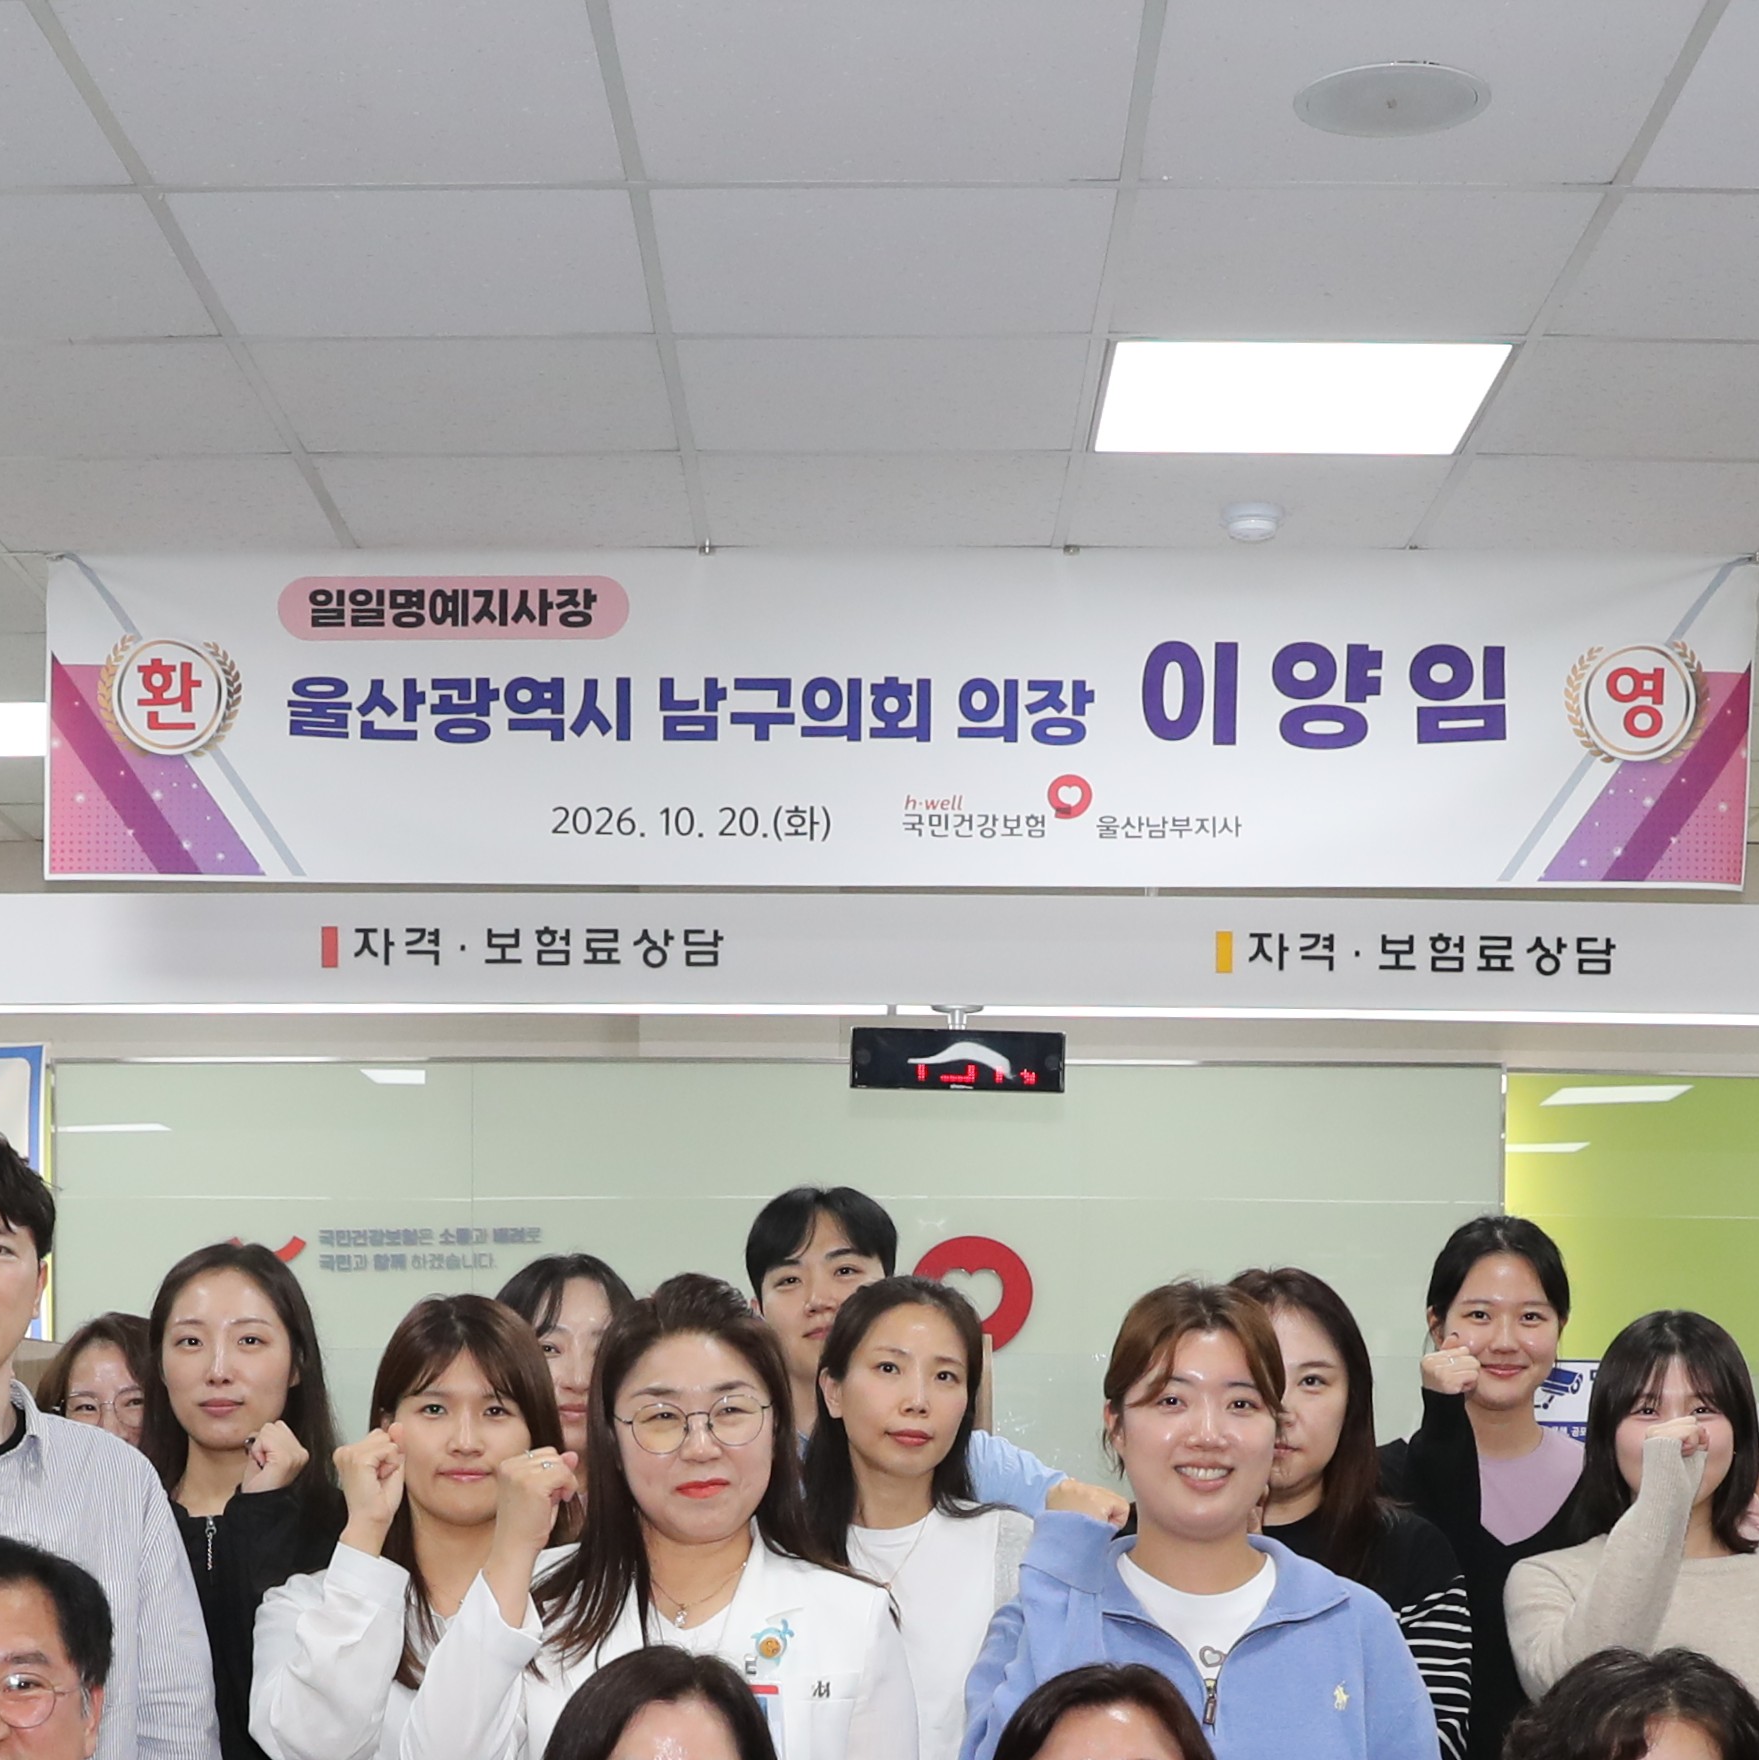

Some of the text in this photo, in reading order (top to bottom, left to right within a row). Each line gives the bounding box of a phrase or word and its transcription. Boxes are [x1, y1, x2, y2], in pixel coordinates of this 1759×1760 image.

[307, 586, 598, 629] 일일명예지사장
[136, 658, 202, 732] 환
[286, 675, 632, 743] 울산광역시
[658, 675, 932, 745] 남구의회
[957, 675, 1095, 746] 의장
[1605, 663, 1666, 741] 영
[551, 803, 646, 840] 2026.
[902, 812, 1046, 840] 국민건강보험
[1096, 814, 1242, 840] 울산남부지사
[353, 927, 441, 967] 자격
[1247, 932, 1335, 972] 자격
